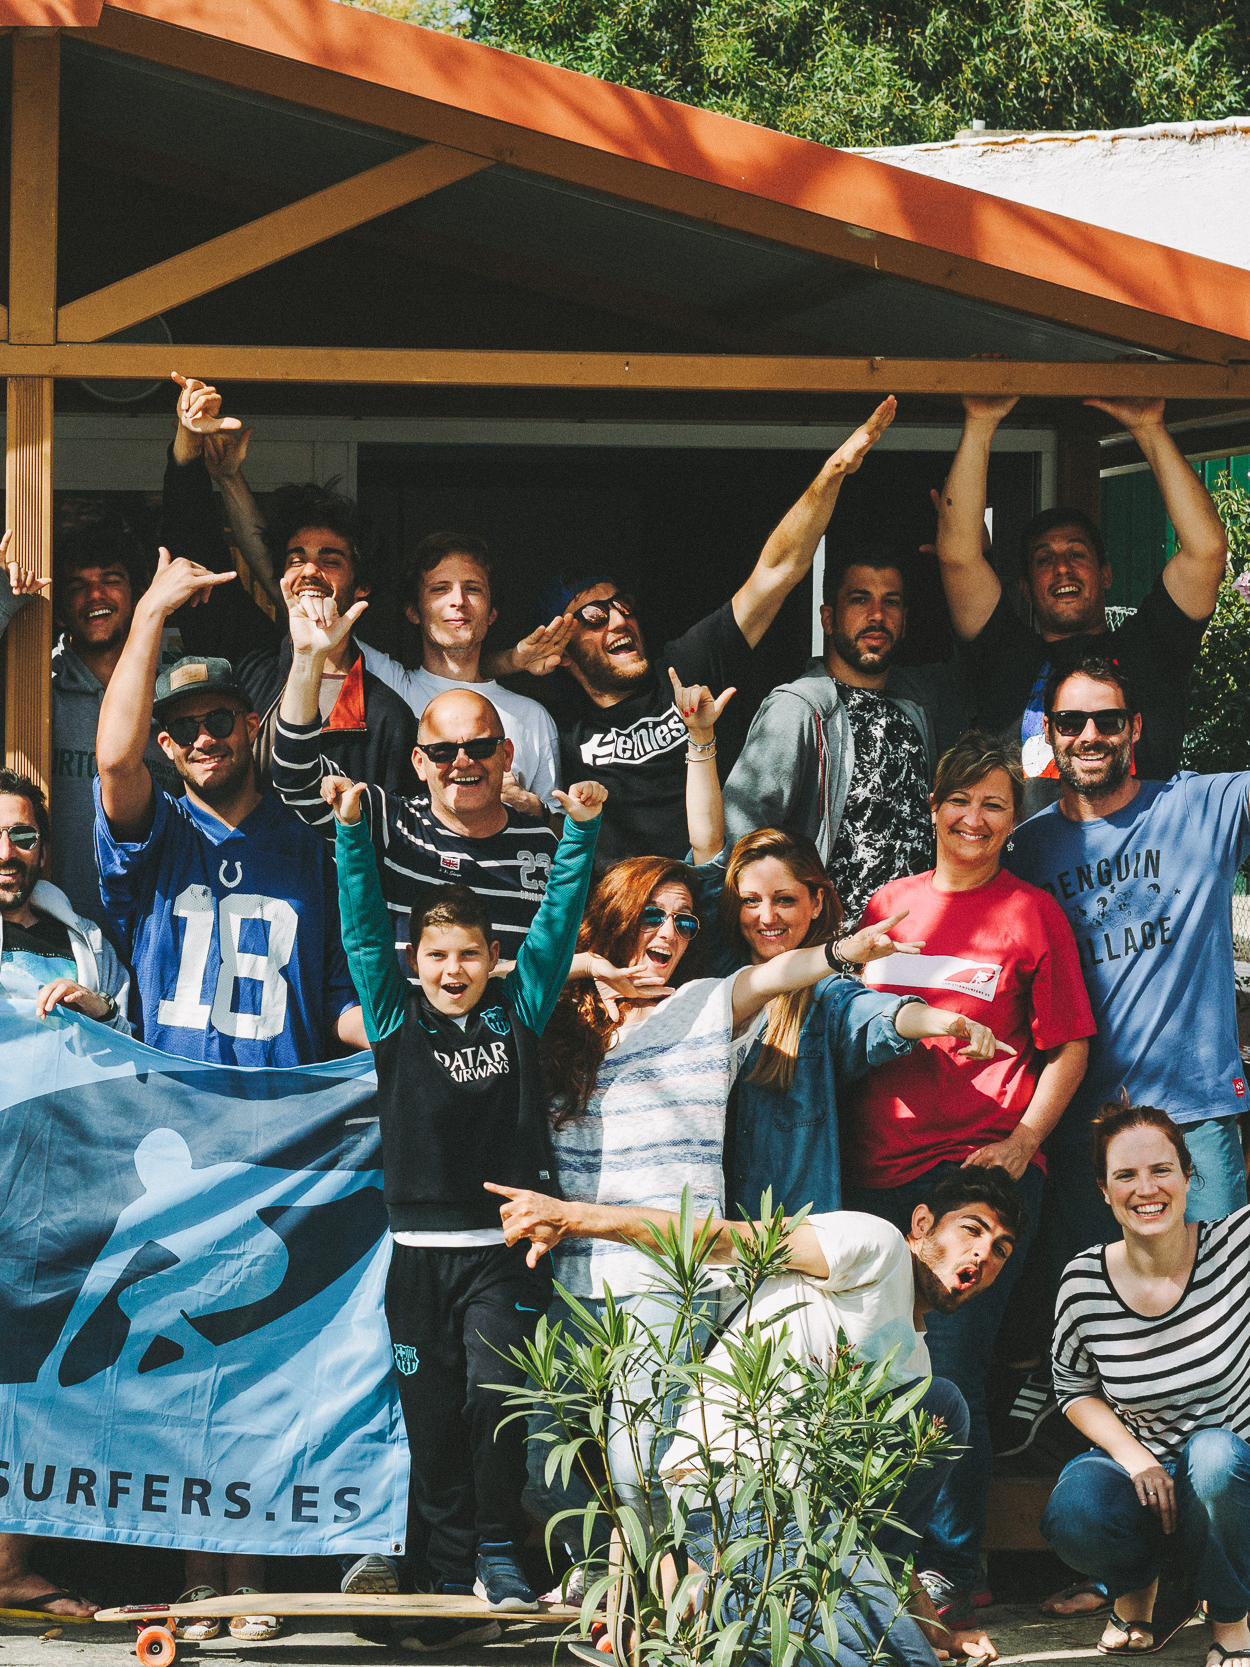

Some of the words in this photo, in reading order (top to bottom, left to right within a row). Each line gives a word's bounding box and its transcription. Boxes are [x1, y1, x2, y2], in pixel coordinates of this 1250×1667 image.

[616, 714, 686, 760] etnies
[157, 883, 299, 1041] 18
[450, 1060, 510, 1083] AIRWAYS
